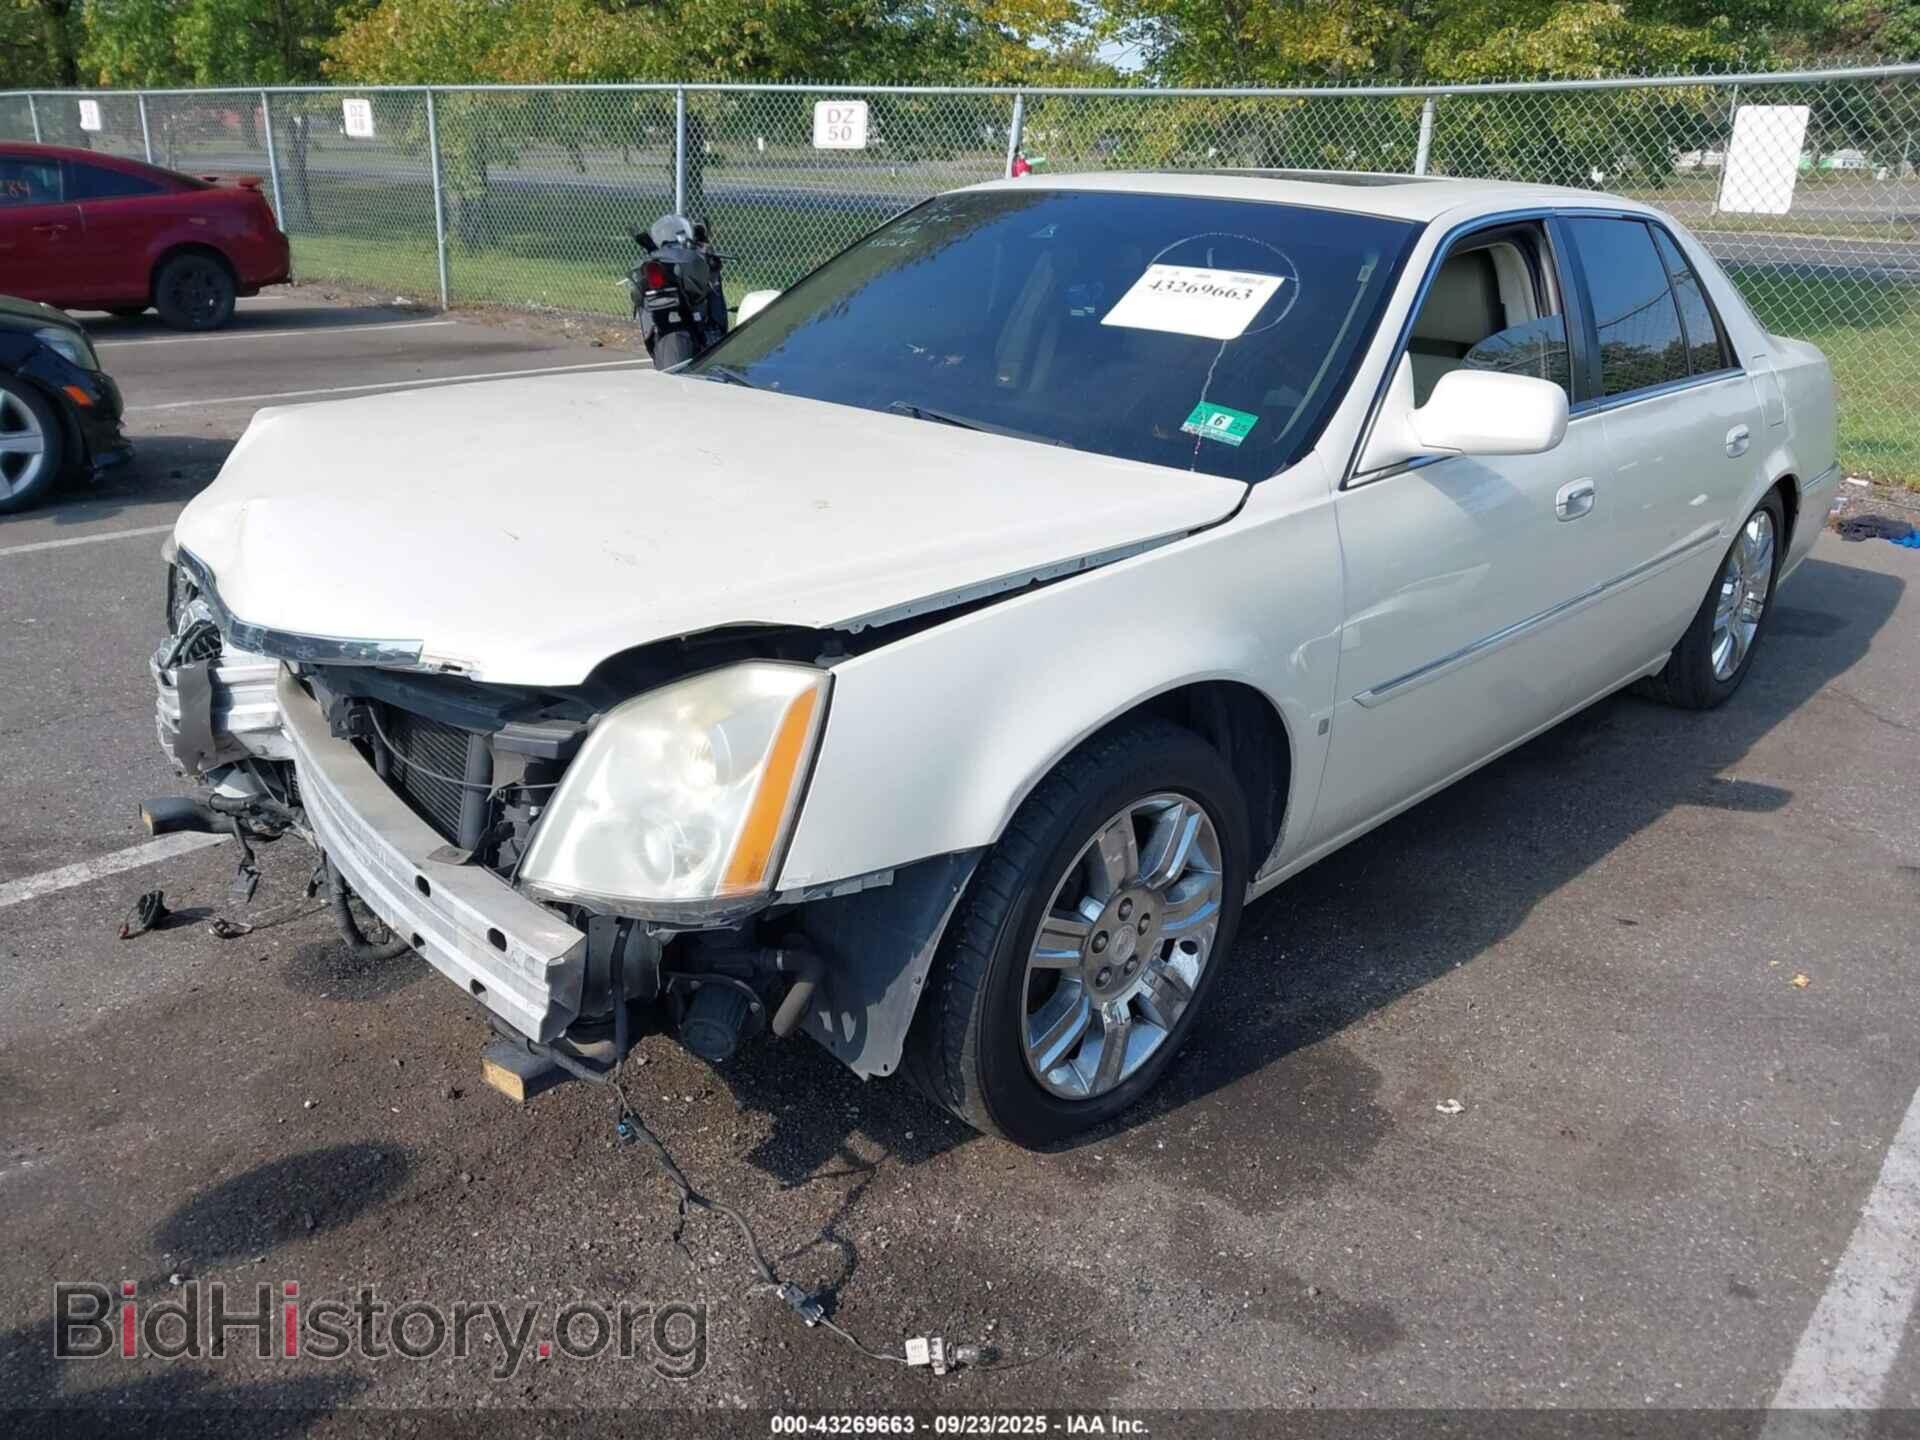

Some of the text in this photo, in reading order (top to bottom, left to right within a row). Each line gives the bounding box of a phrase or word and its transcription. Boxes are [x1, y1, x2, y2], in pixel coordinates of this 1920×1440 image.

[827, 108, 855, 124] DZ
[827, 126, 852, 142] 50
[1148, 279, 1253, 301] 43269663
[1213, 415, 1227, 427] 6
